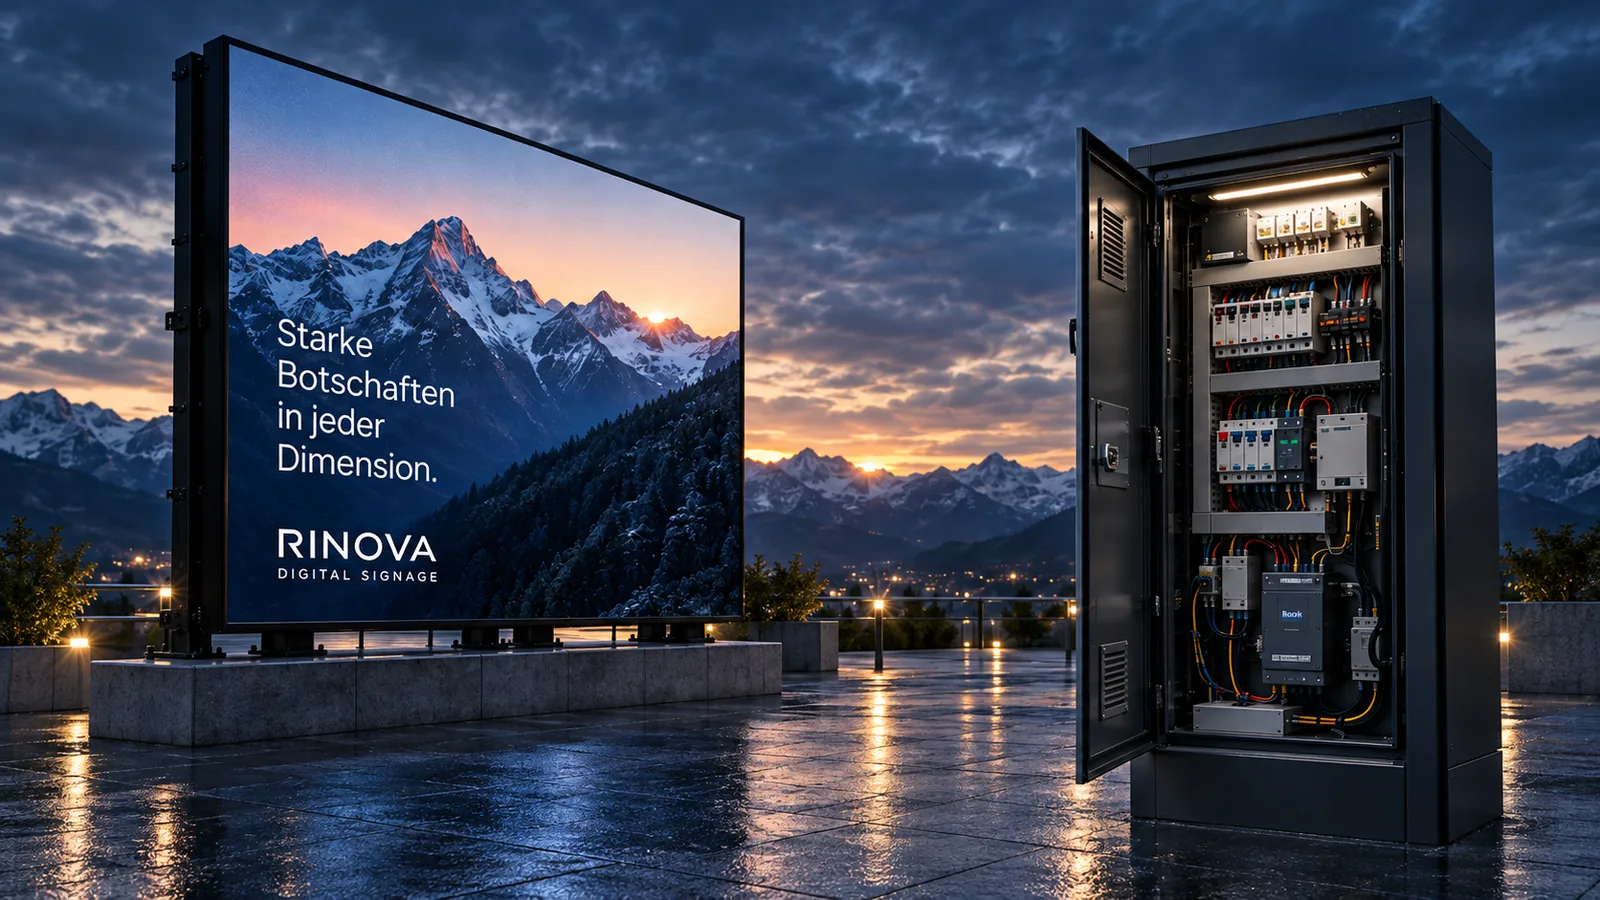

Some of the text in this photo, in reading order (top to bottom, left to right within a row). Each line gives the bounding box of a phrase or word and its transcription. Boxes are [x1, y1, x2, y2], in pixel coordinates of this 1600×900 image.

[277, 318, 373, 358] Starke
[277, 359, 455, 408] Botschaften
[277, 400, 385, 440] in jeder
[277, 443, 438, 483] Dimension.
[277, 528, 437, 563] RINOVA
[277, 568, 438, 583] DIGITAL SIGNAGE
